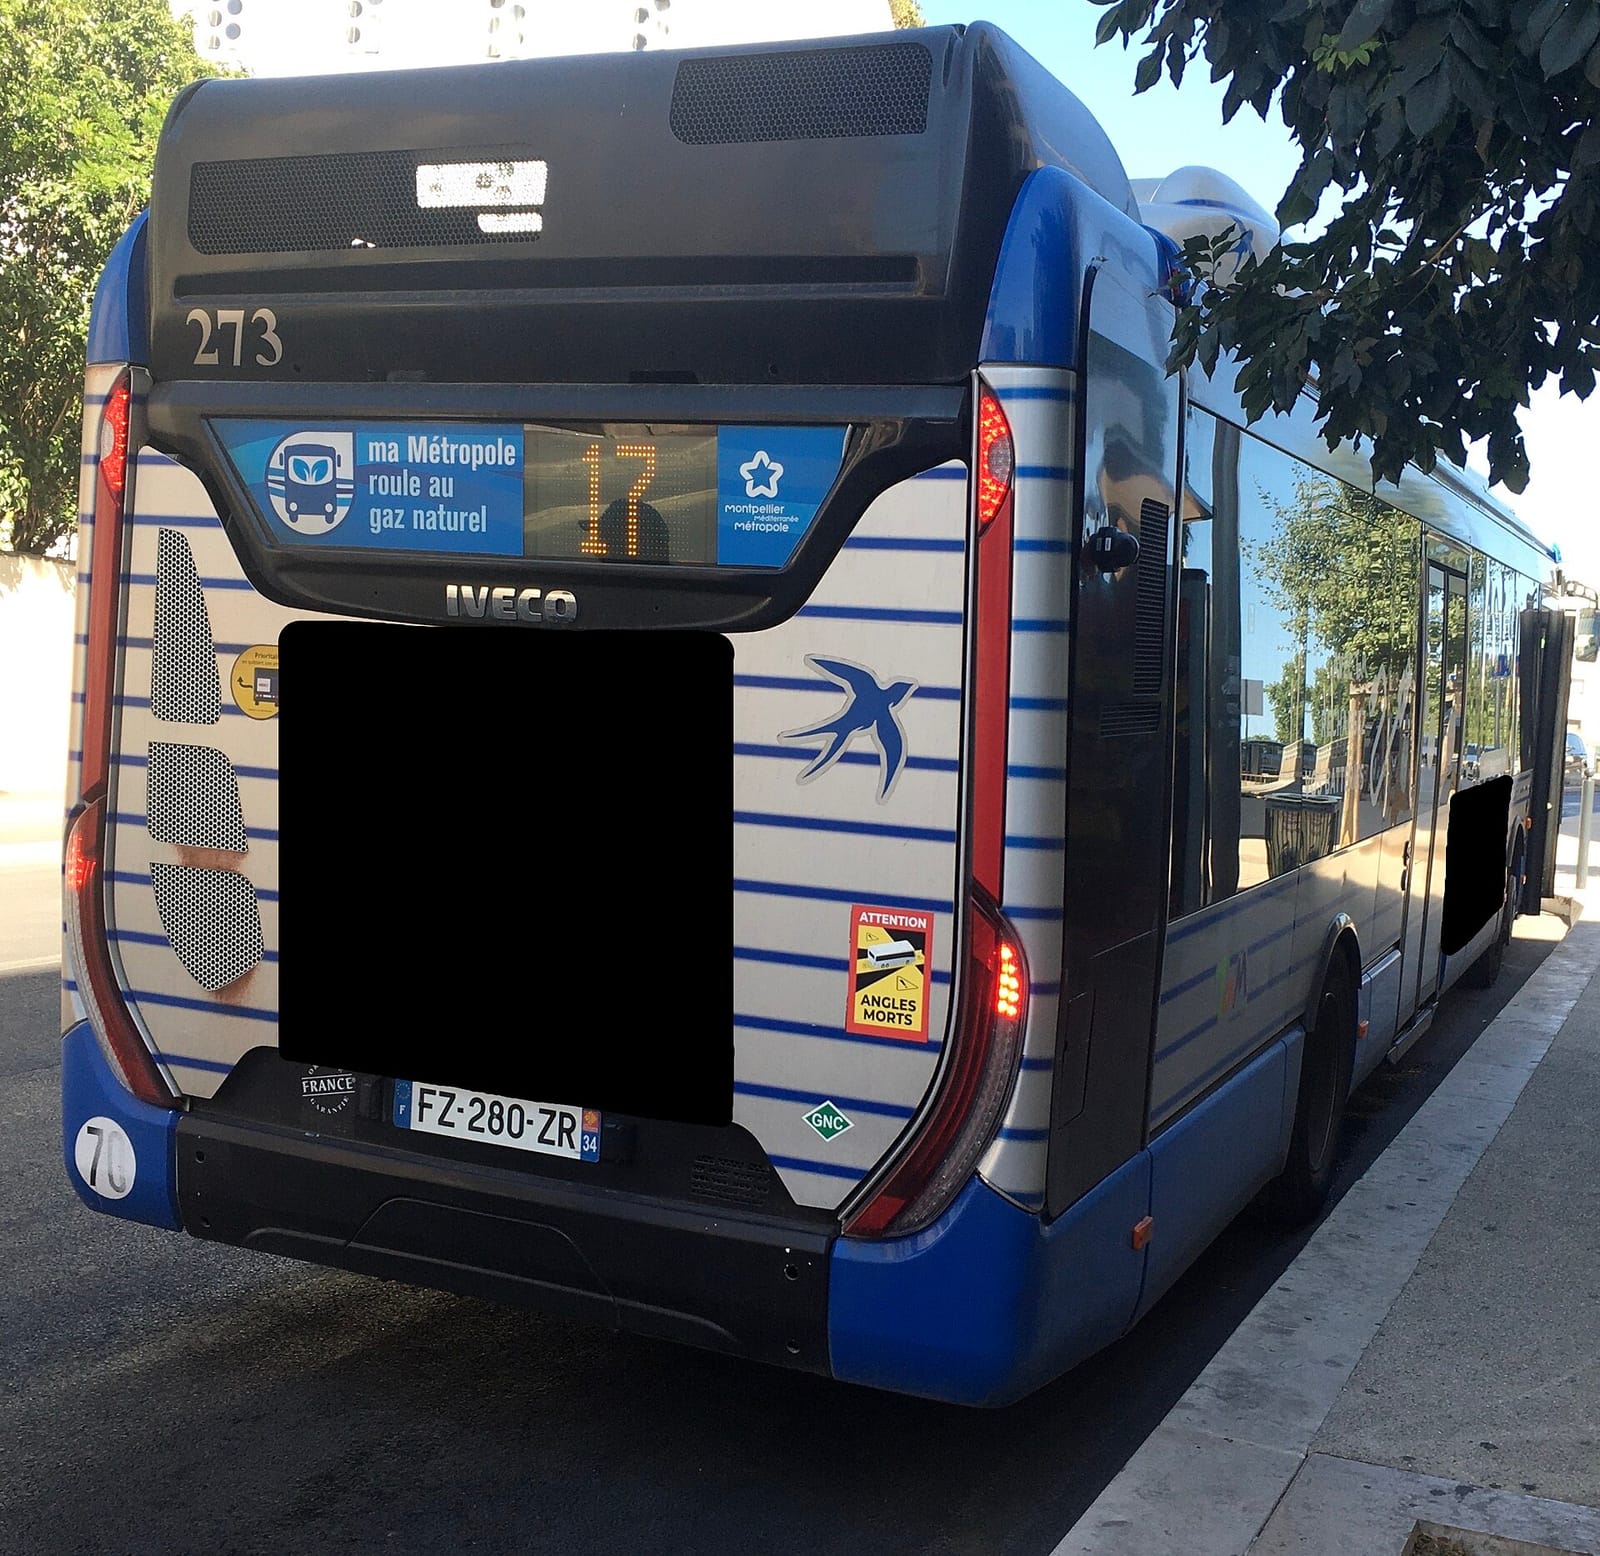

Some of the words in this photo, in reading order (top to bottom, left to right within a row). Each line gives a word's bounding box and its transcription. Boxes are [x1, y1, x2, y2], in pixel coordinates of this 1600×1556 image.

[186, 308, 284, 367] 273
[368, 440, 399, 463] ma
[407, 435, 516, 472] Métropole
[369, 470, 421, 497] roule
[429, 477, 454, 499] au
[580, 442, 657, 557] 17
[369, 507, 405, 534] gaz
[413, 504, 487, 533] naturel
[446, 584, 578, 623] IVECO
[859, 911, 927, 929] ATTENTION
[860, 994, 917, 1012] ANGLES
[863, 1010, 913, 1026] MORTS
[302, 1077, 354, 1093] FRANCE
[399, 1104, 406, 1115] F
[418, 1087, 577, 1149] FZ-280-ZR
[582, 1135, 598, 1153] 34
[811, 1113, 844, 1130] GNC
